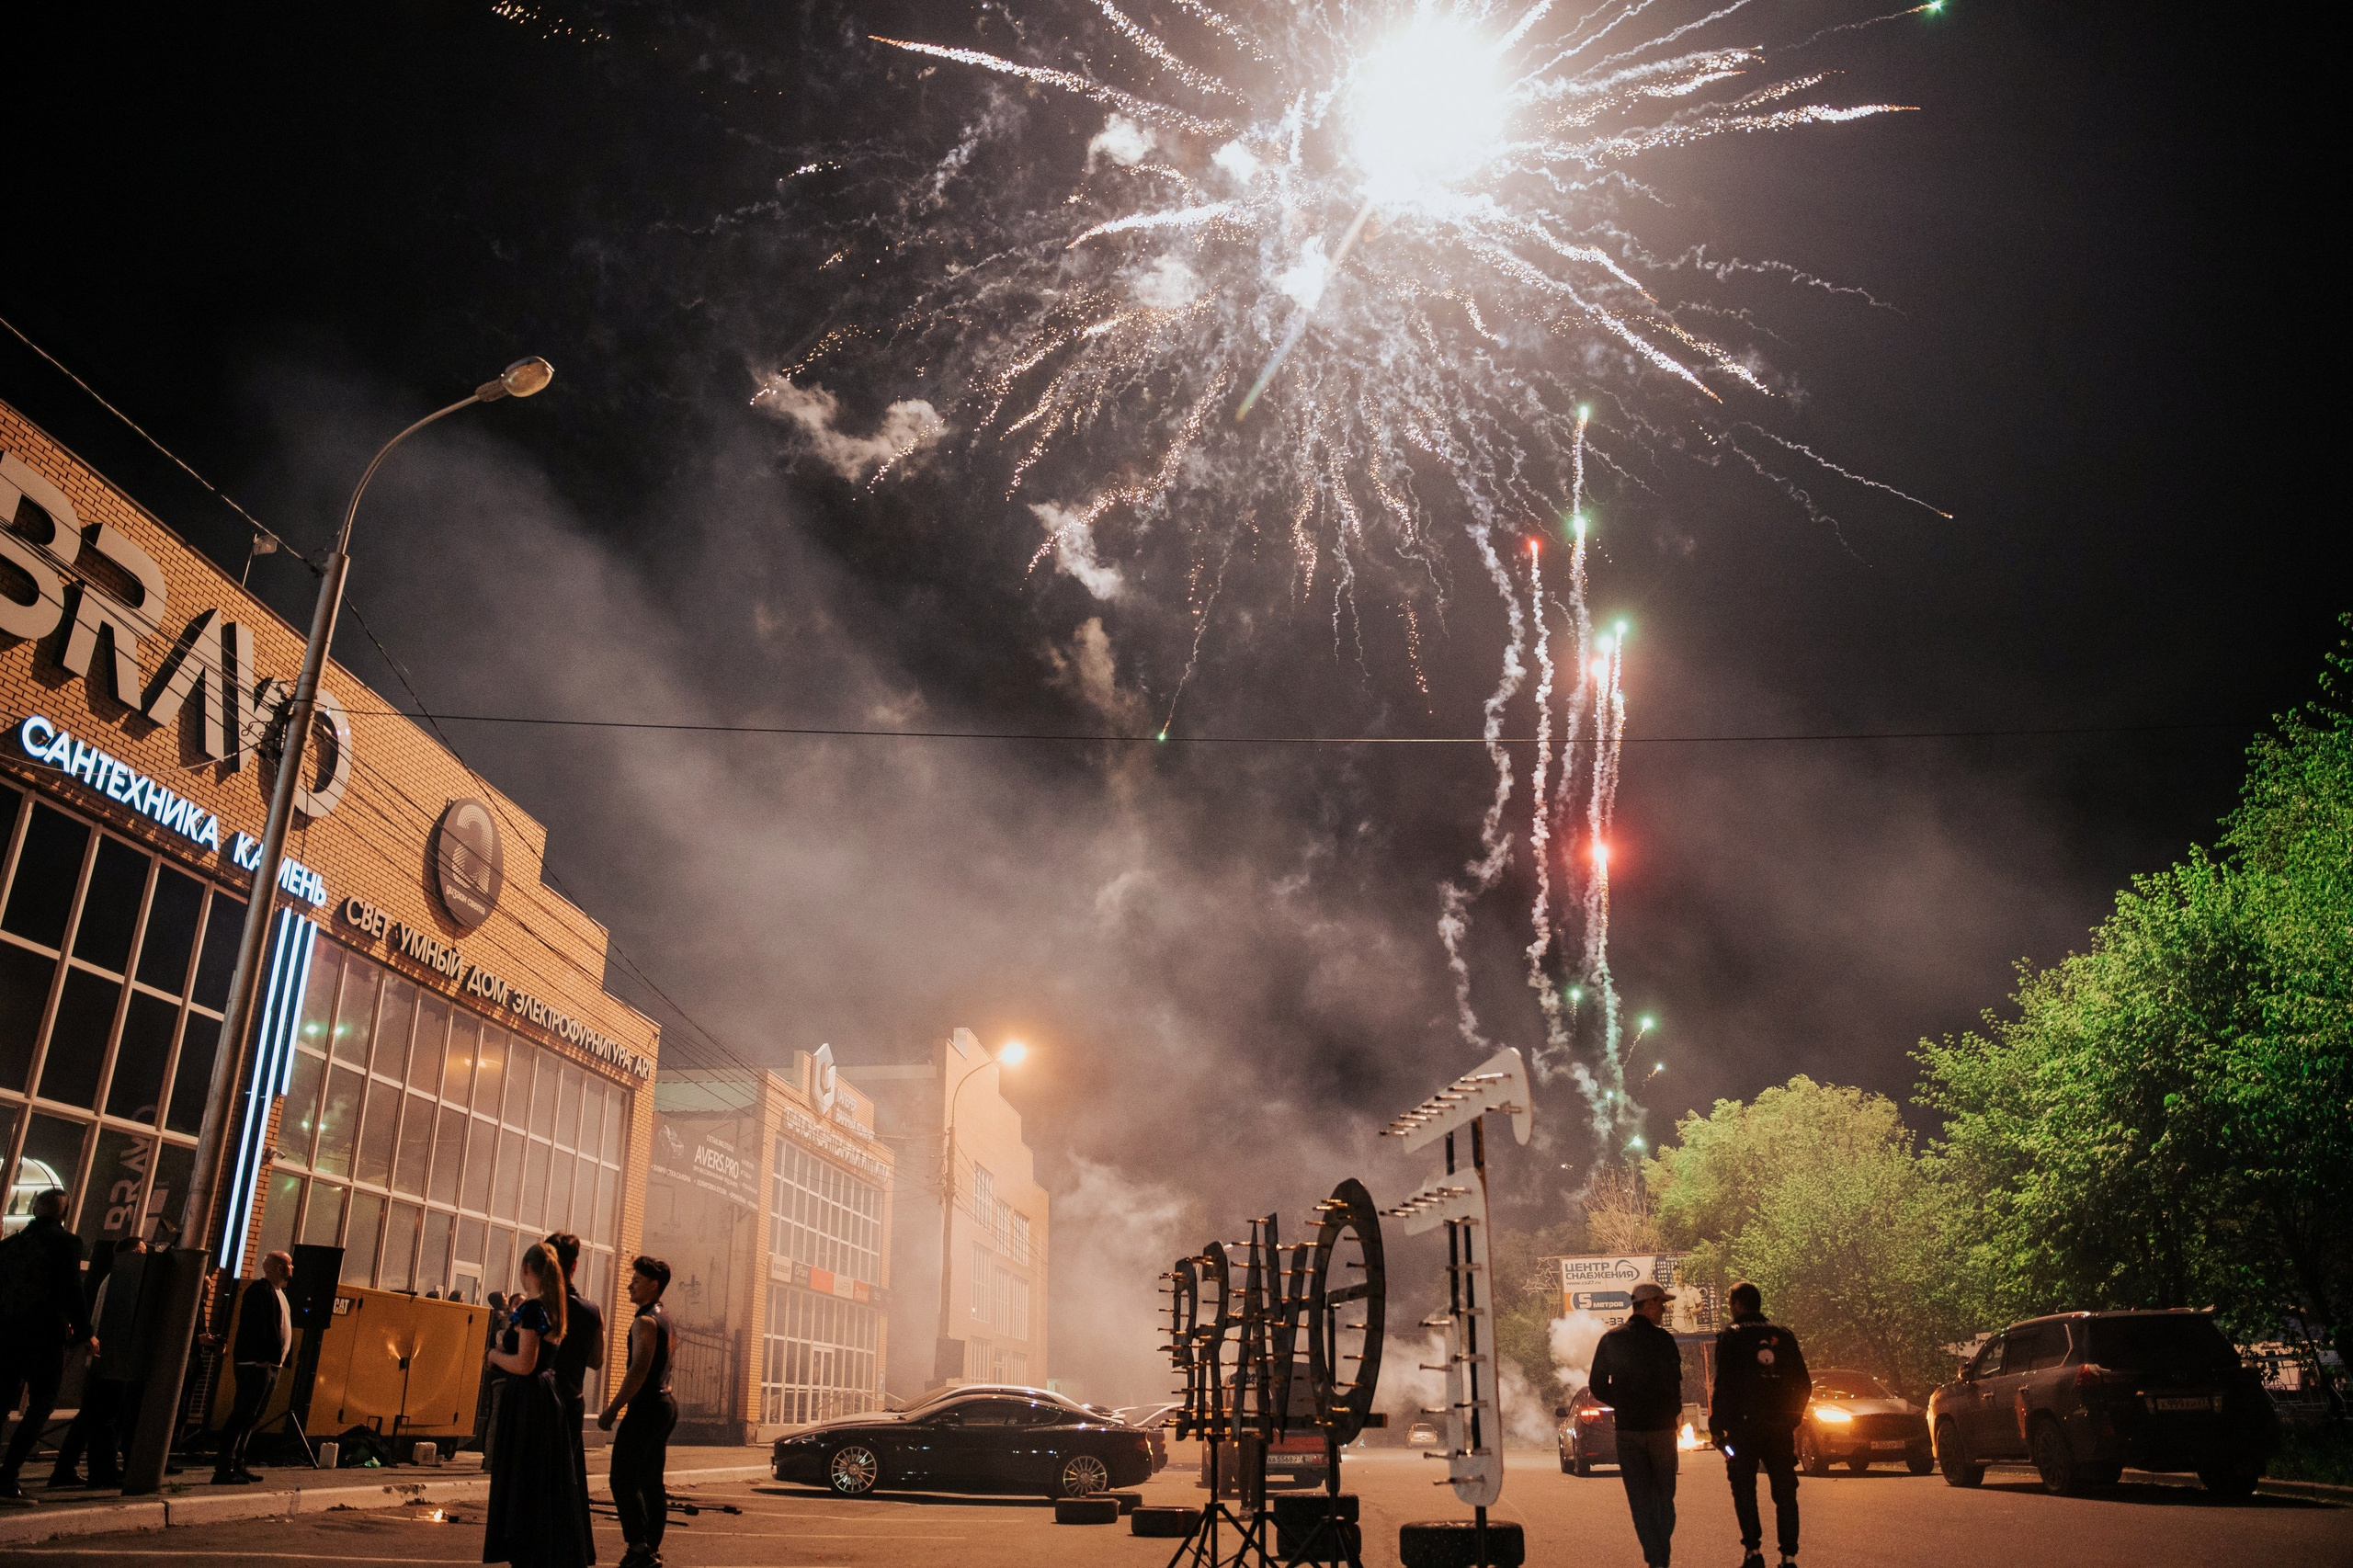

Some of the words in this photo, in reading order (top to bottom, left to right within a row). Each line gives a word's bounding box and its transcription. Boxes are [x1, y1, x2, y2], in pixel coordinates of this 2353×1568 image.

[0, 449, 352, 817] BRAVO
[21, 714, 220, 852] САНТЕХНИКА
[347, 895, 395, 941] СВЕТ
[398, 922, 463, 982] УМНЫЙ
[467, 966, 510, 1006] ДОМ
[512, 989, 631, 1073] ЭЛЕКТРОФУРНИТУРА
[634, 1054, 656, 1081] ART
[694, 1144, 739, 1179] AVERS.PRO
[1564, 1262, 1610, 1272] ЦЕНТР
[1565, 1270, 1634, 1279] СНАБЖЕНИЯ
[333, 1297, 349, 1314] CAT
[1578, 1293, 1592, 1309] 5
